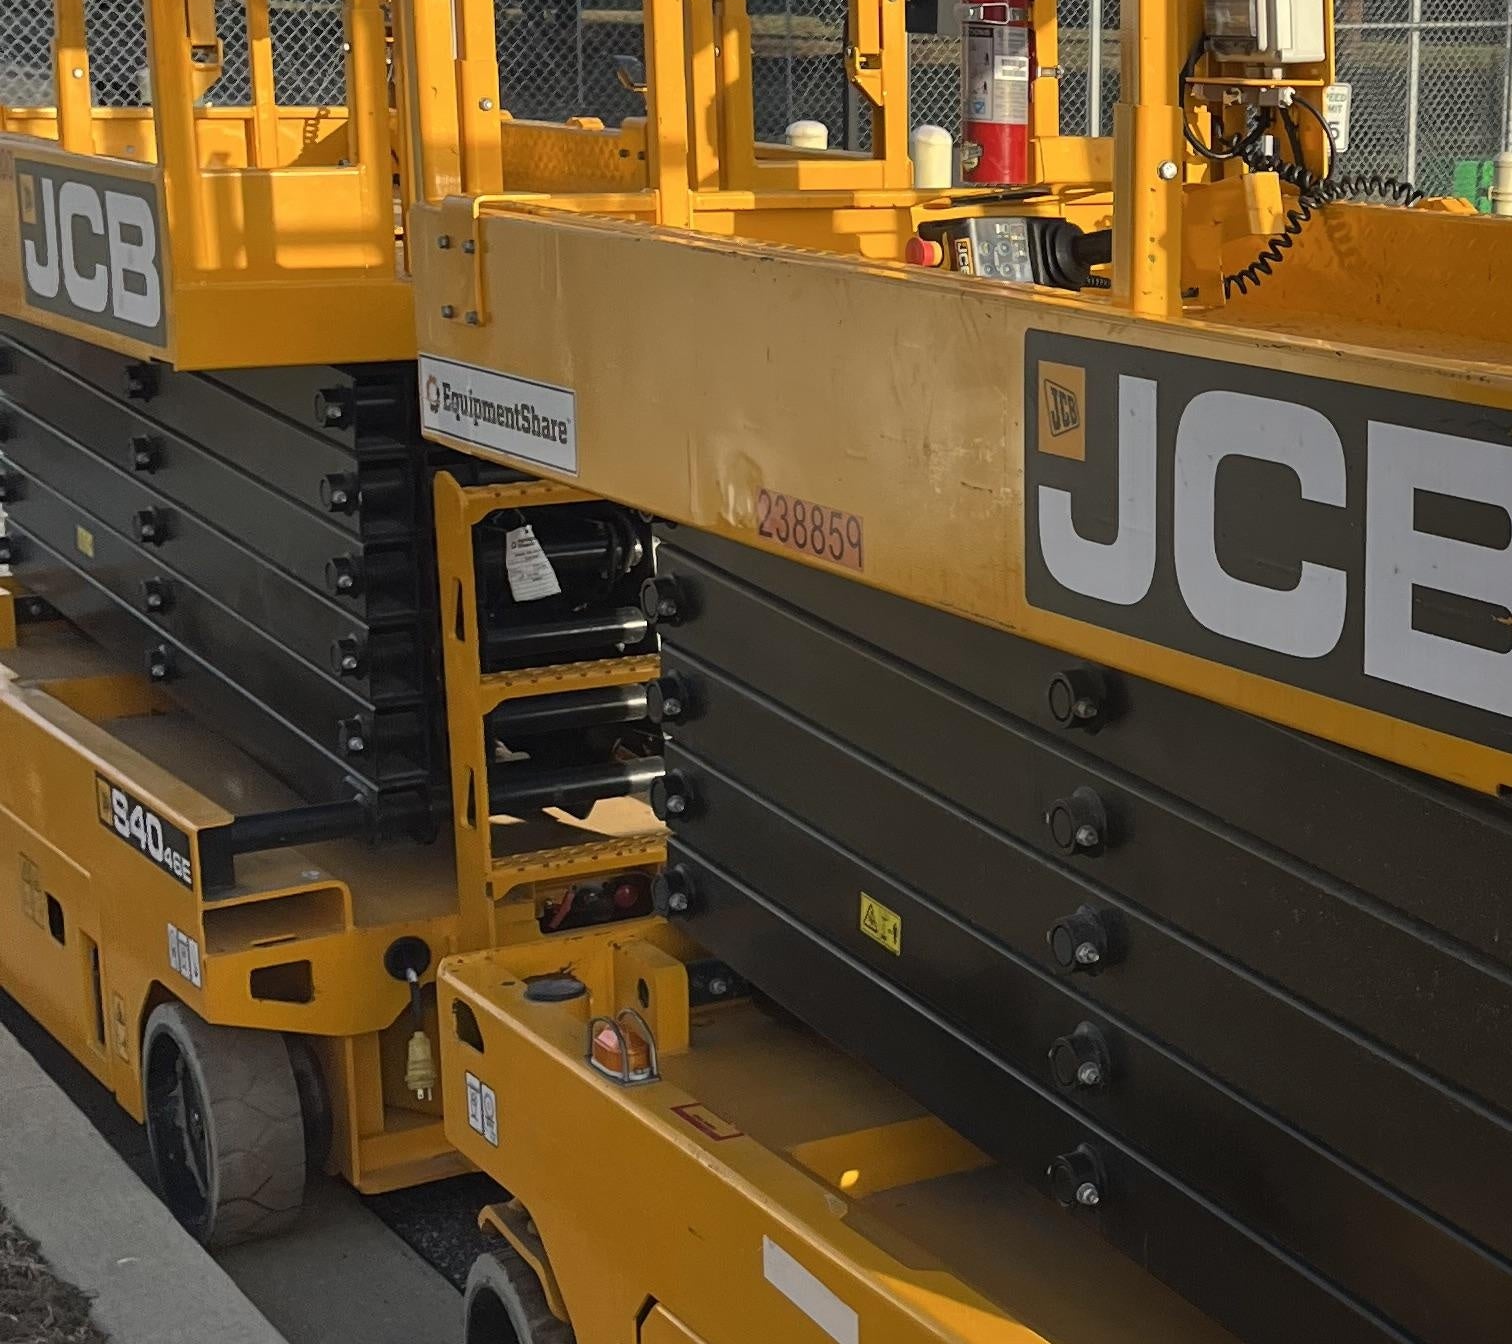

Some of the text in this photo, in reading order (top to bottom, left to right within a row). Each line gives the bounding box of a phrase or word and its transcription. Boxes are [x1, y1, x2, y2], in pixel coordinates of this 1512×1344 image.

[24, 177, 161, 328] JCB
[442, 382, 568, 445] EquipmentShare
[1050, 385, 1078, 431] JCB
[759, 489, 862, 568] 238859
